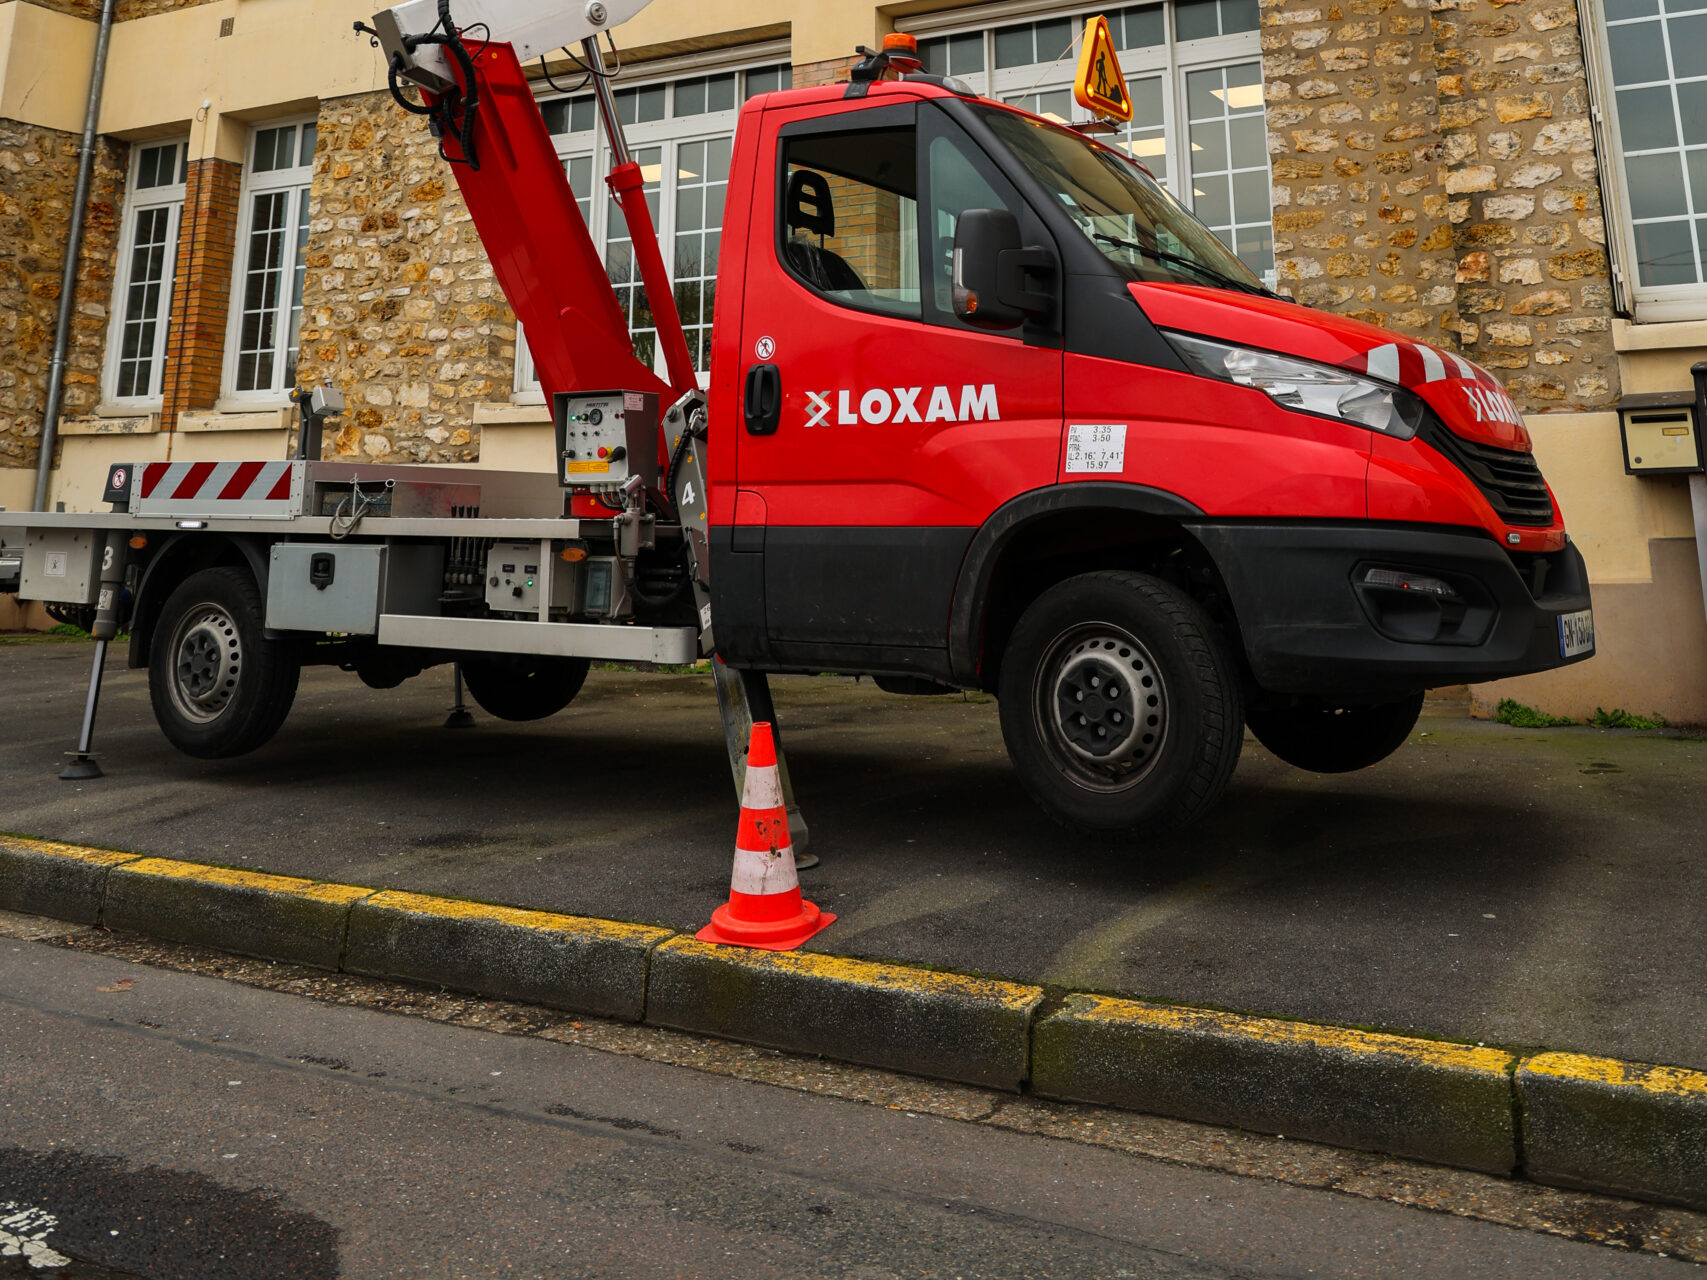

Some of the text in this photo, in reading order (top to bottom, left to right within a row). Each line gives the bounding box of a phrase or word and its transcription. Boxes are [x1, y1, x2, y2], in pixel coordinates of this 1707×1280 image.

[838, 383, 1001, 425] LOXAM
[682, 481, 695, 506] 4
[102, 545, 114, 570] 3
